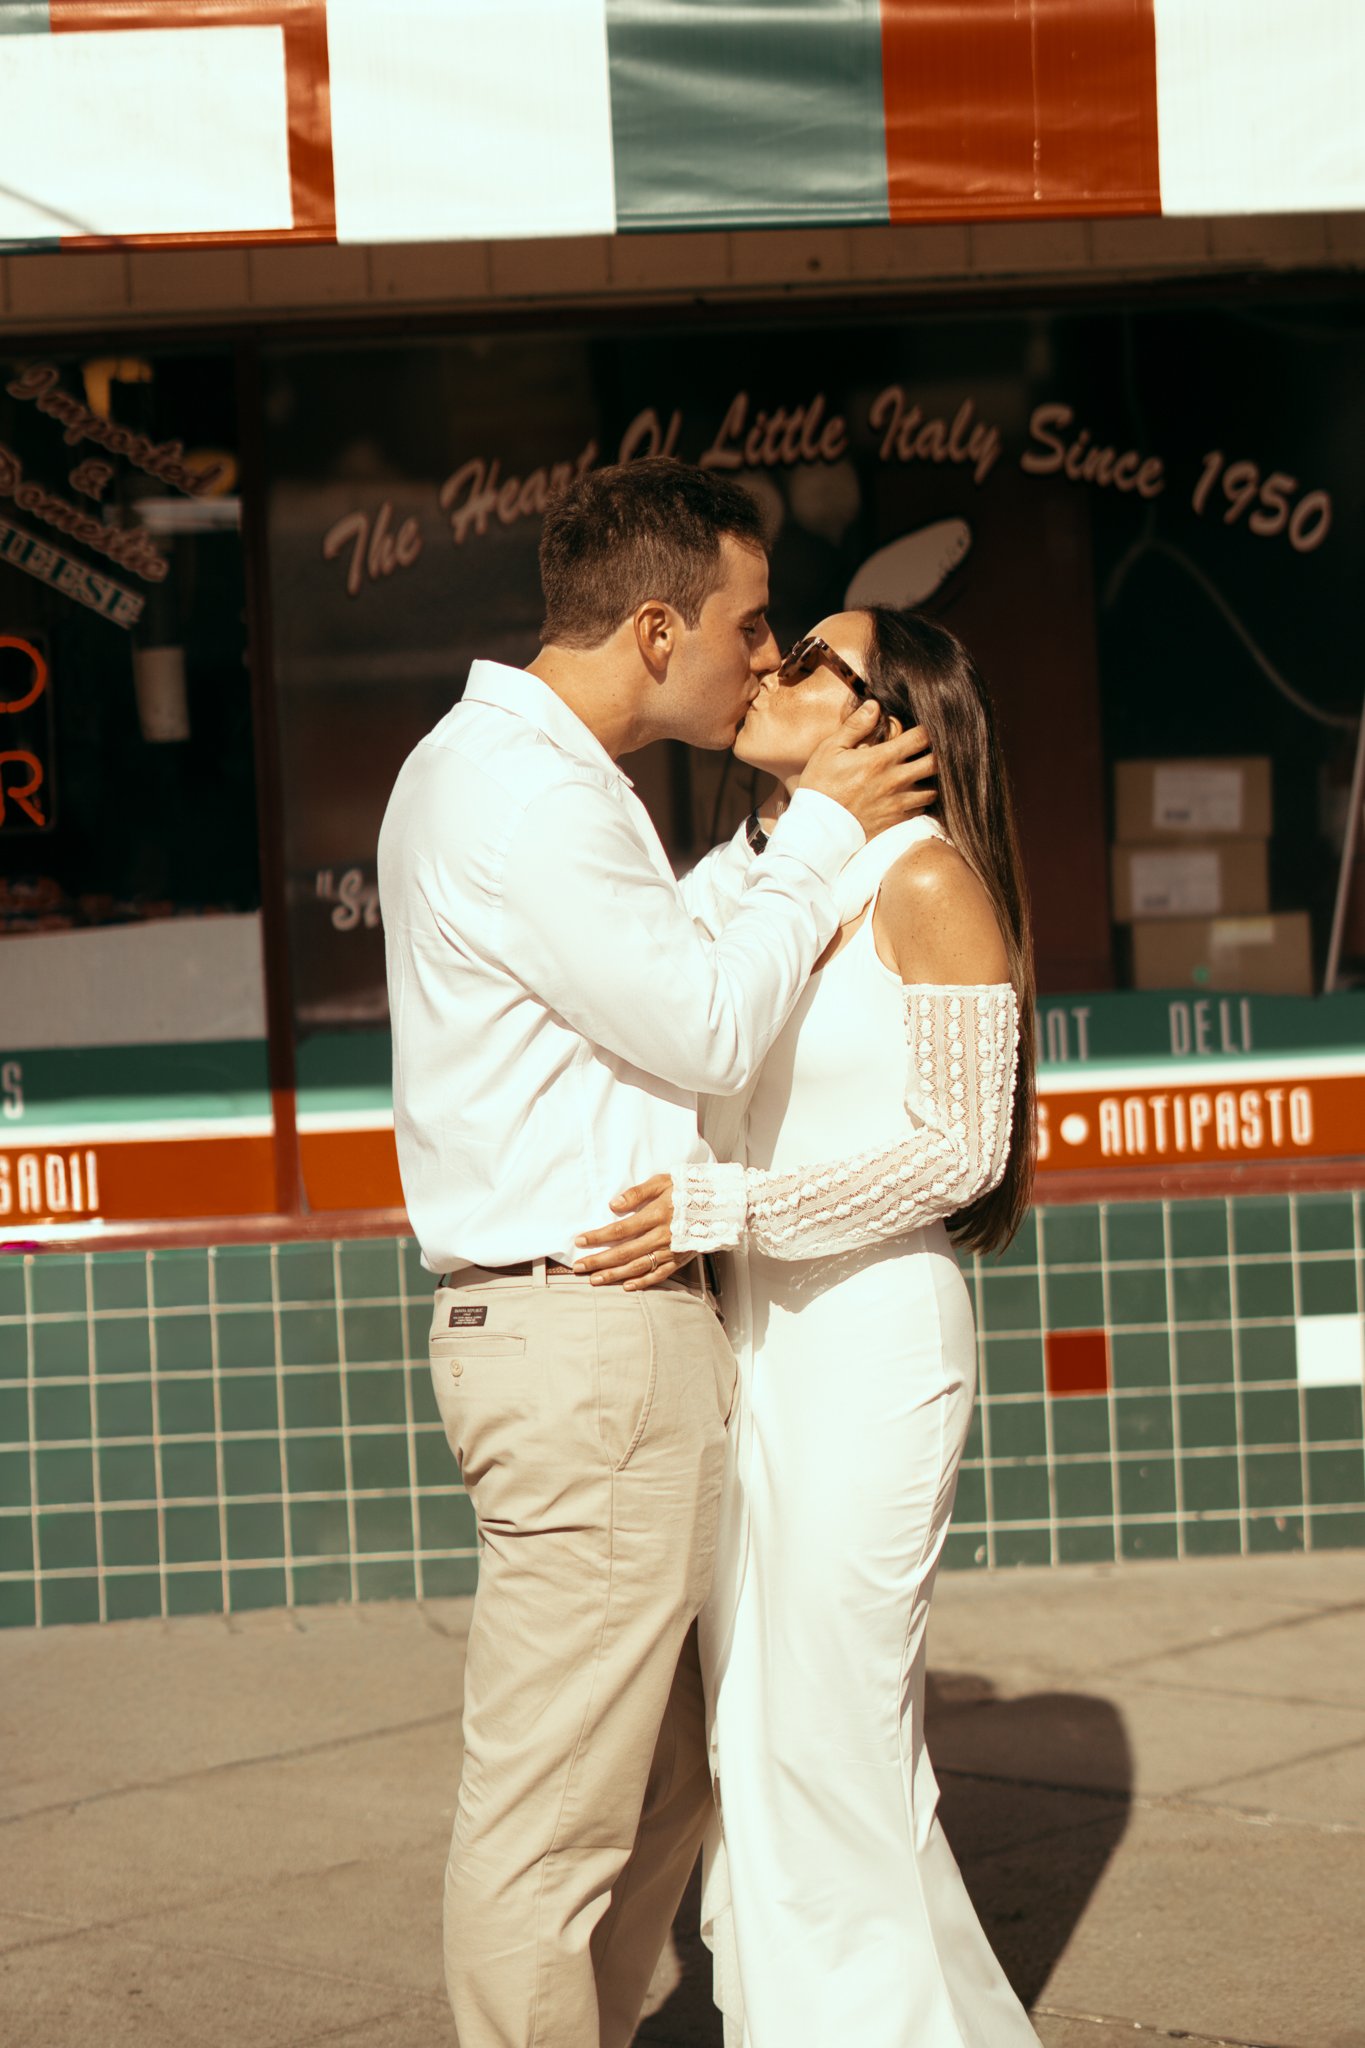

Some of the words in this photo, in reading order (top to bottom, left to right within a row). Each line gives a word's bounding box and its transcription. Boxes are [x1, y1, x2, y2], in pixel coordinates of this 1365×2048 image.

[322, 501, 423, 598] The
[700, 389, 850, 470] Little
[868, 383, 1001, 486] Italy
[1020, 402, 1166, 499] Since
[1190, 449, 1333, 554] 1950
[1036, 1007, 1091, 1063] NT
[1168, 998, 1253, 1056] DELI
[1099, 1086, 1315, 1157] ANTIPASTO
